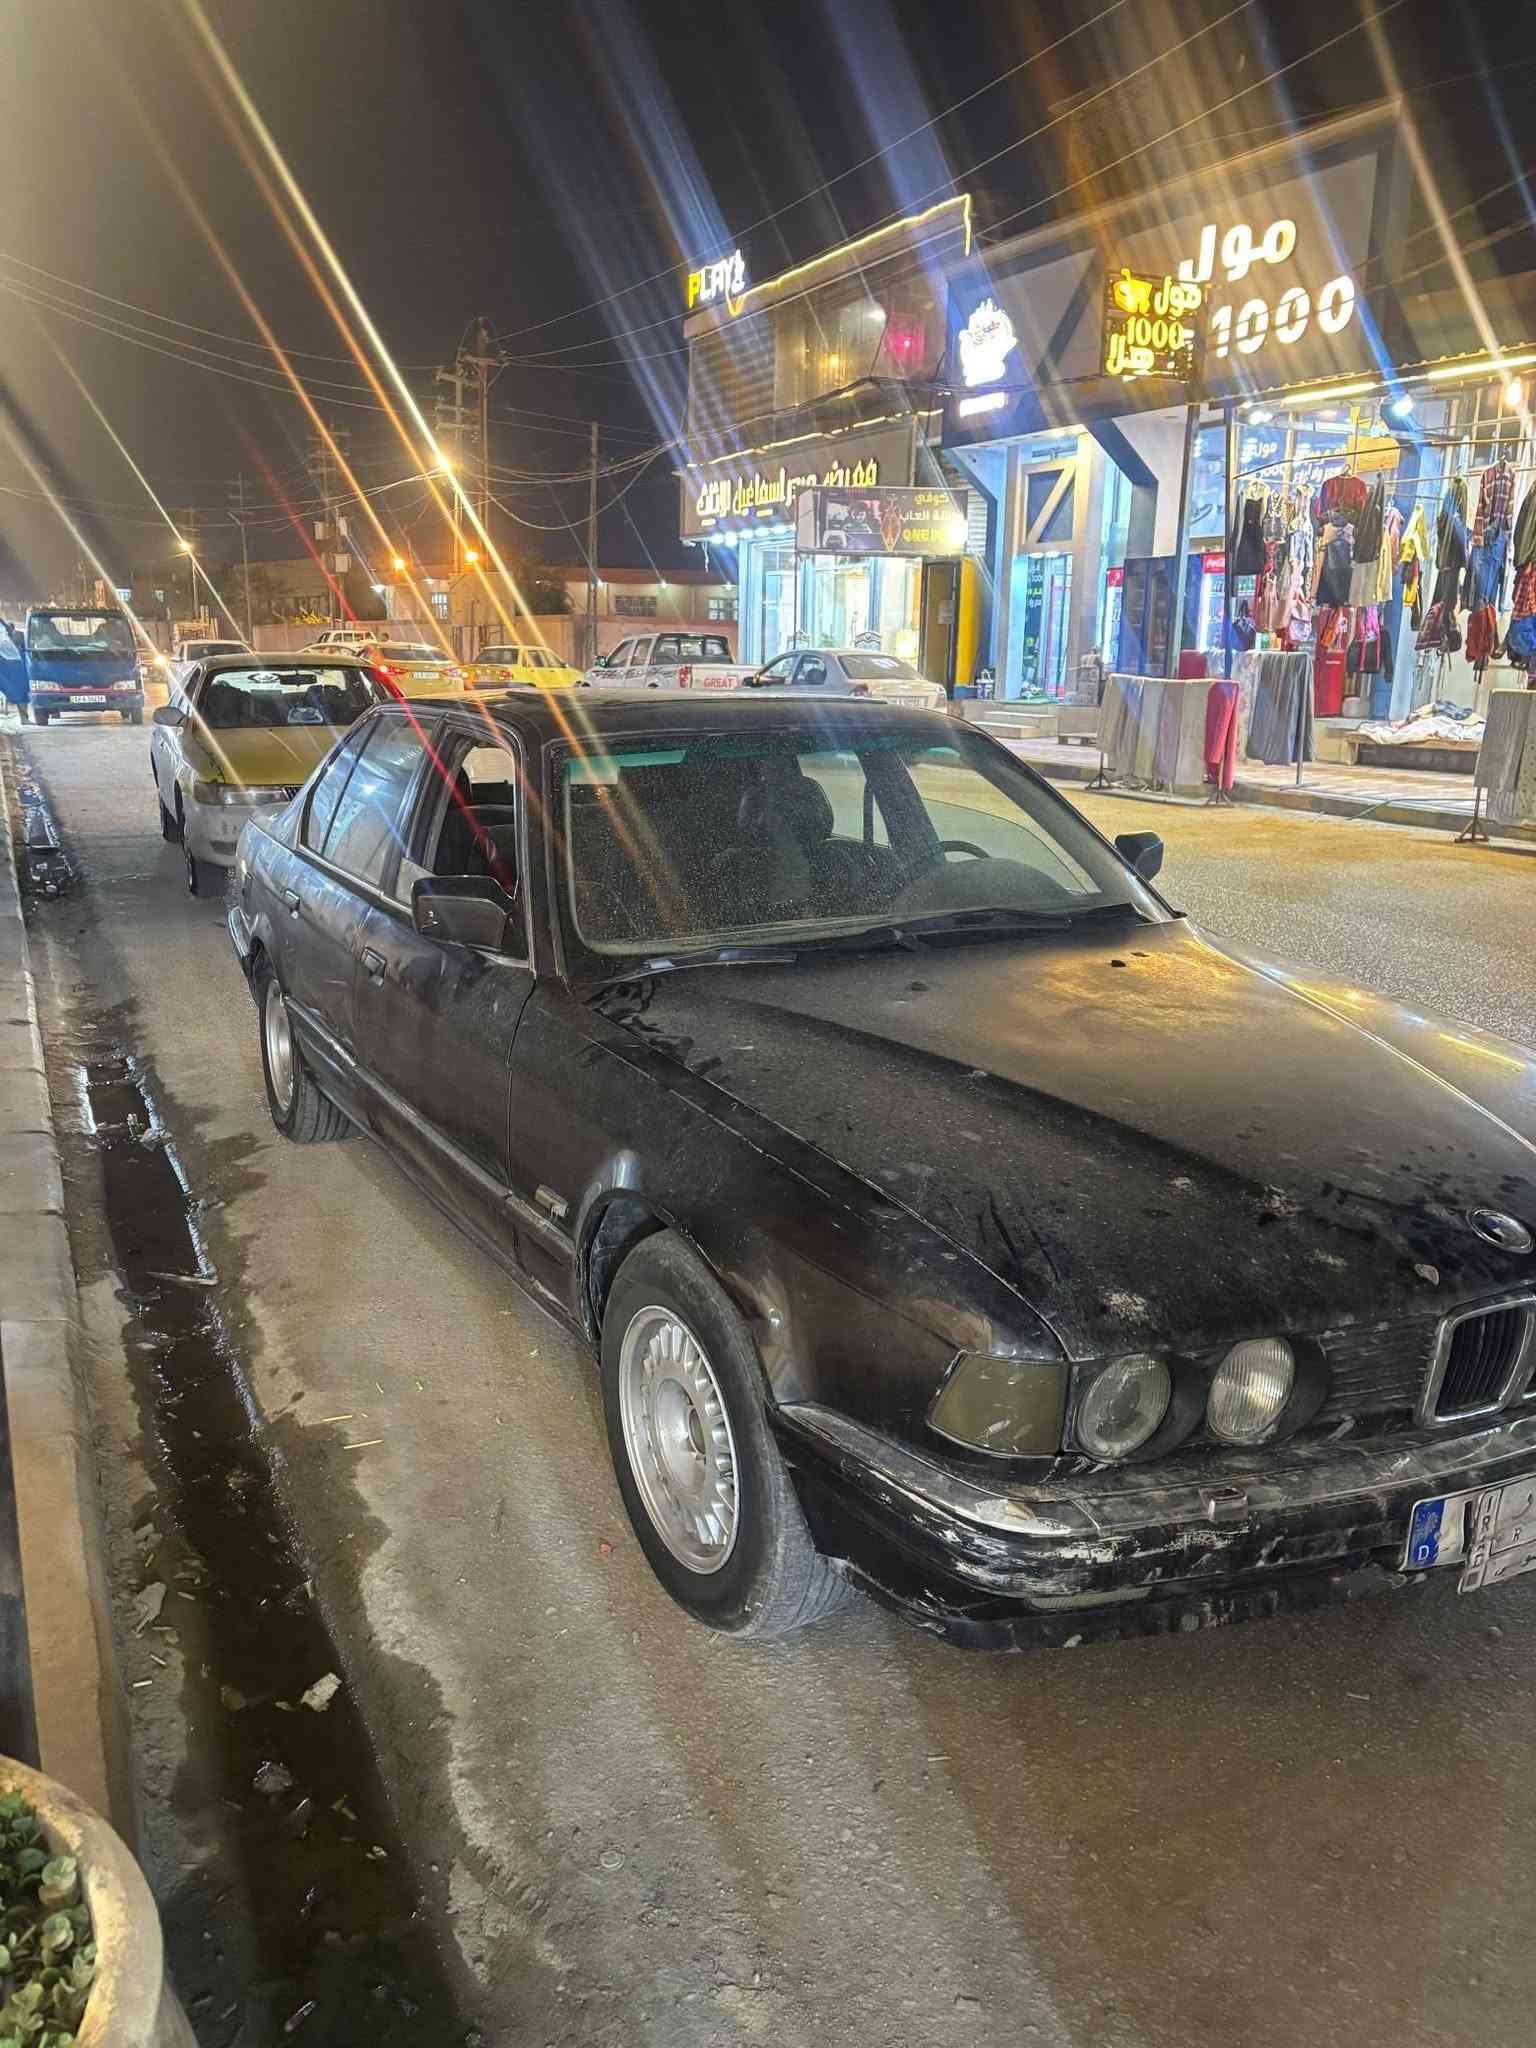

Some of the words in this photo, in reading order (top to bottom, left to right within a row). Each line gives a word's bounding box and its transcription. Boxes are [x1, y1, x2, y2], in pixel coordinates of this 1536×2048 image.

[1178, 219, 1297, 282] مول
[1126, 315, 1185, 351] 1000
[1210, 275, 1355, 359] 1000
[704, 678, 733, 688] GREAT
[1418, 1545, 1430, 1562] D
